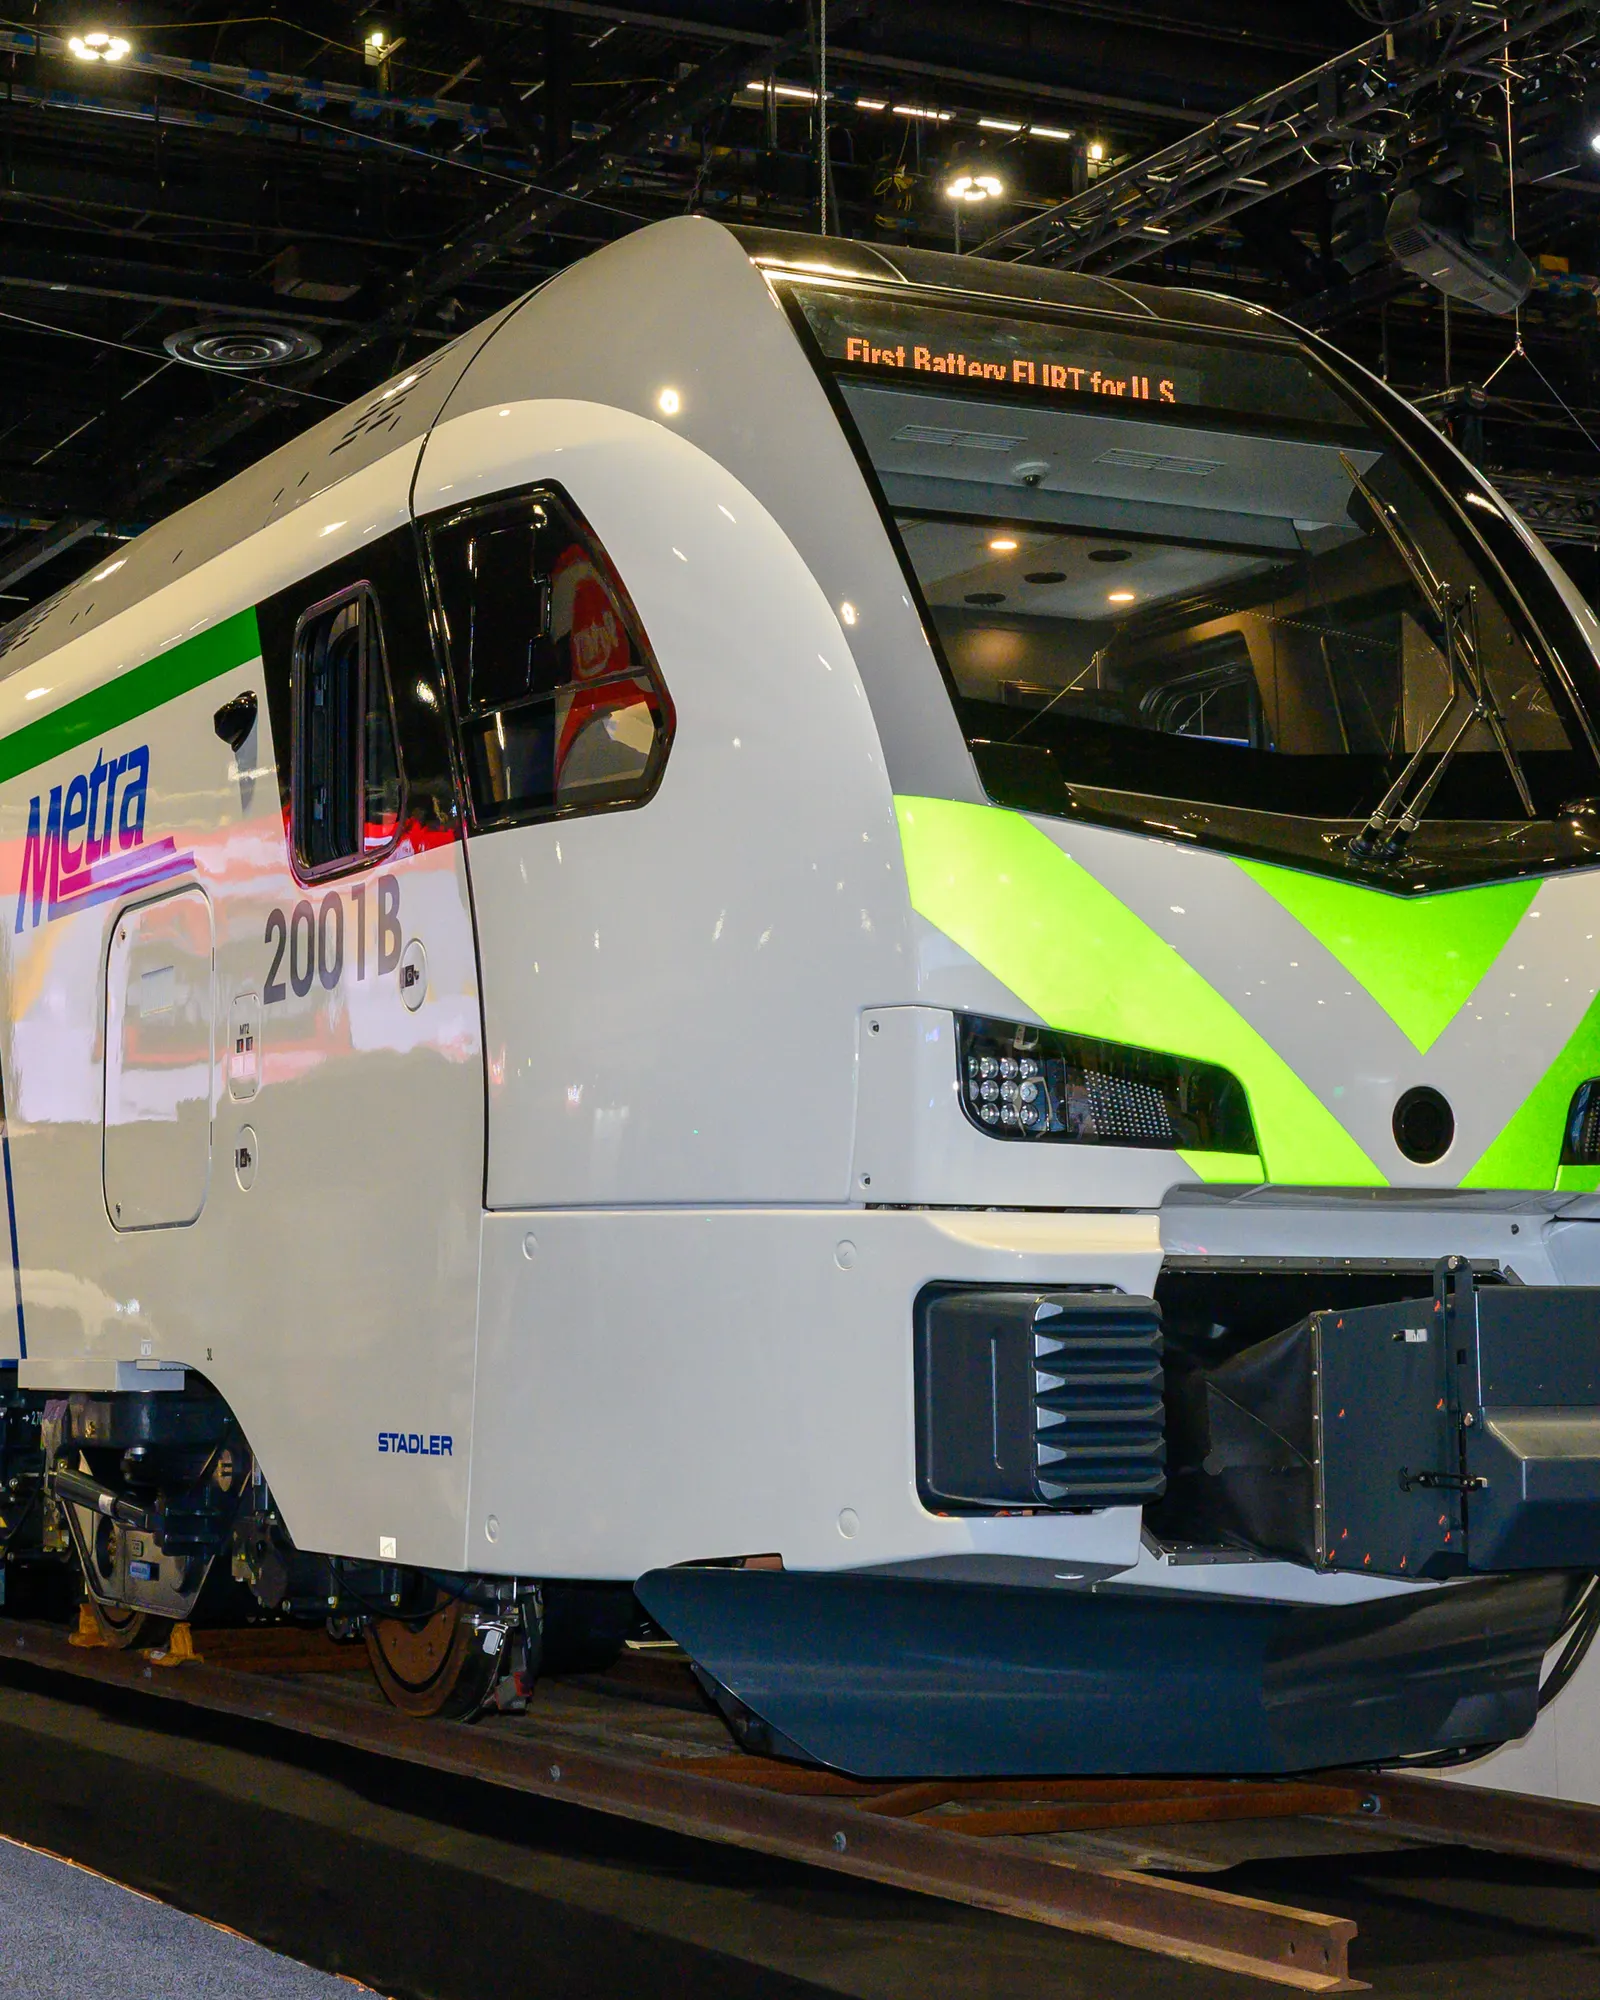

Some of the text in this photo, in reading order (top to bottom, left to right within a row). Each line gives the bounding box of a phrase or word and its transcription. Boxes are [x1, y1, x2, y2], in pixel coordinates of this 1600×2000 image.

[846, 337, 906, 367] First
[1090, 370, 1126, 396] for
[15, 745, 149, 934] Metra
[263, 873, 402, 1005] 2001B
[378, 1432, 453, 1456] STADLER
